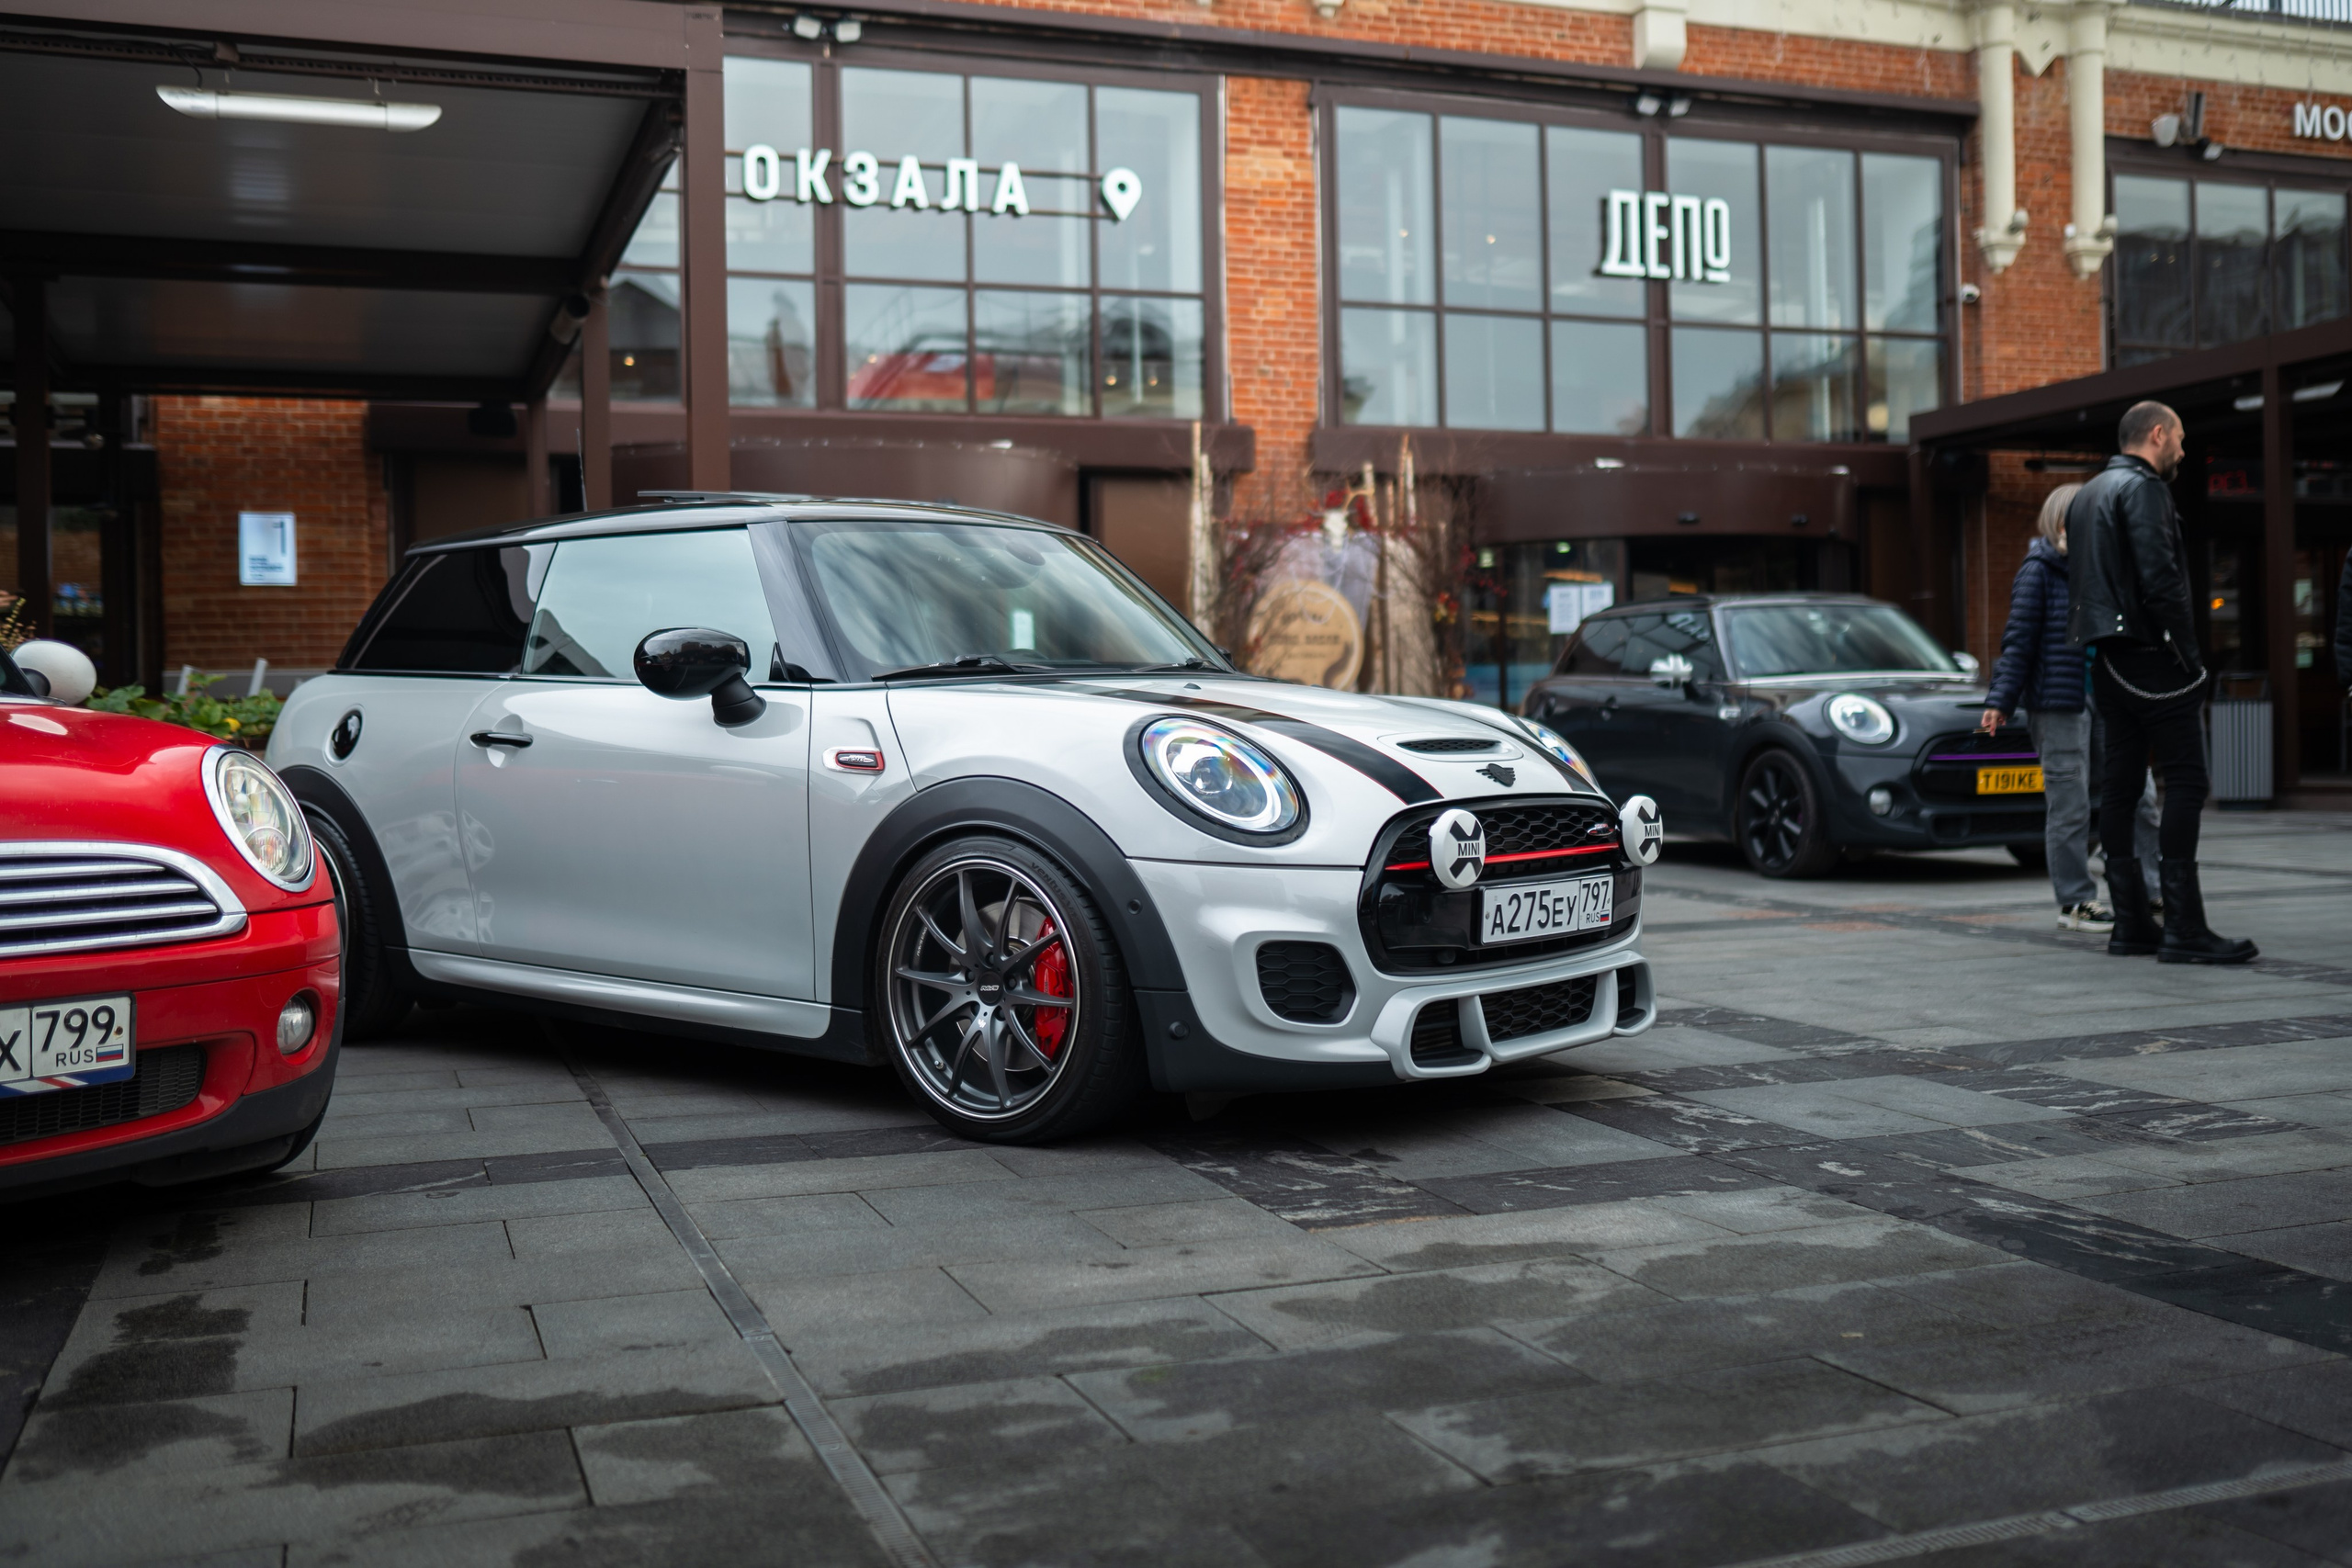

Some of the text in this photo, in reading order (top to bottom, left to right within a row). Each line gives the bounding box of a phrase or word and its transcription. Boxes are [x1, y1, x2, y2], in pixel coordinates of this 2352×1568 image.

[2294, 101, 2352, 141] МО
[742, 143, 1030, 216] ОКЗАЛА
[1601, 188, 1731, 283] ДЕПО
[1457, 842, 1480, 856] MINI
[1582, 880, 1610, 912] 797
[1586, 911, 1600, 924] RUS
[36, 1005, 116, 1053] 799
[56, 1048, 95, 1067] RUS
